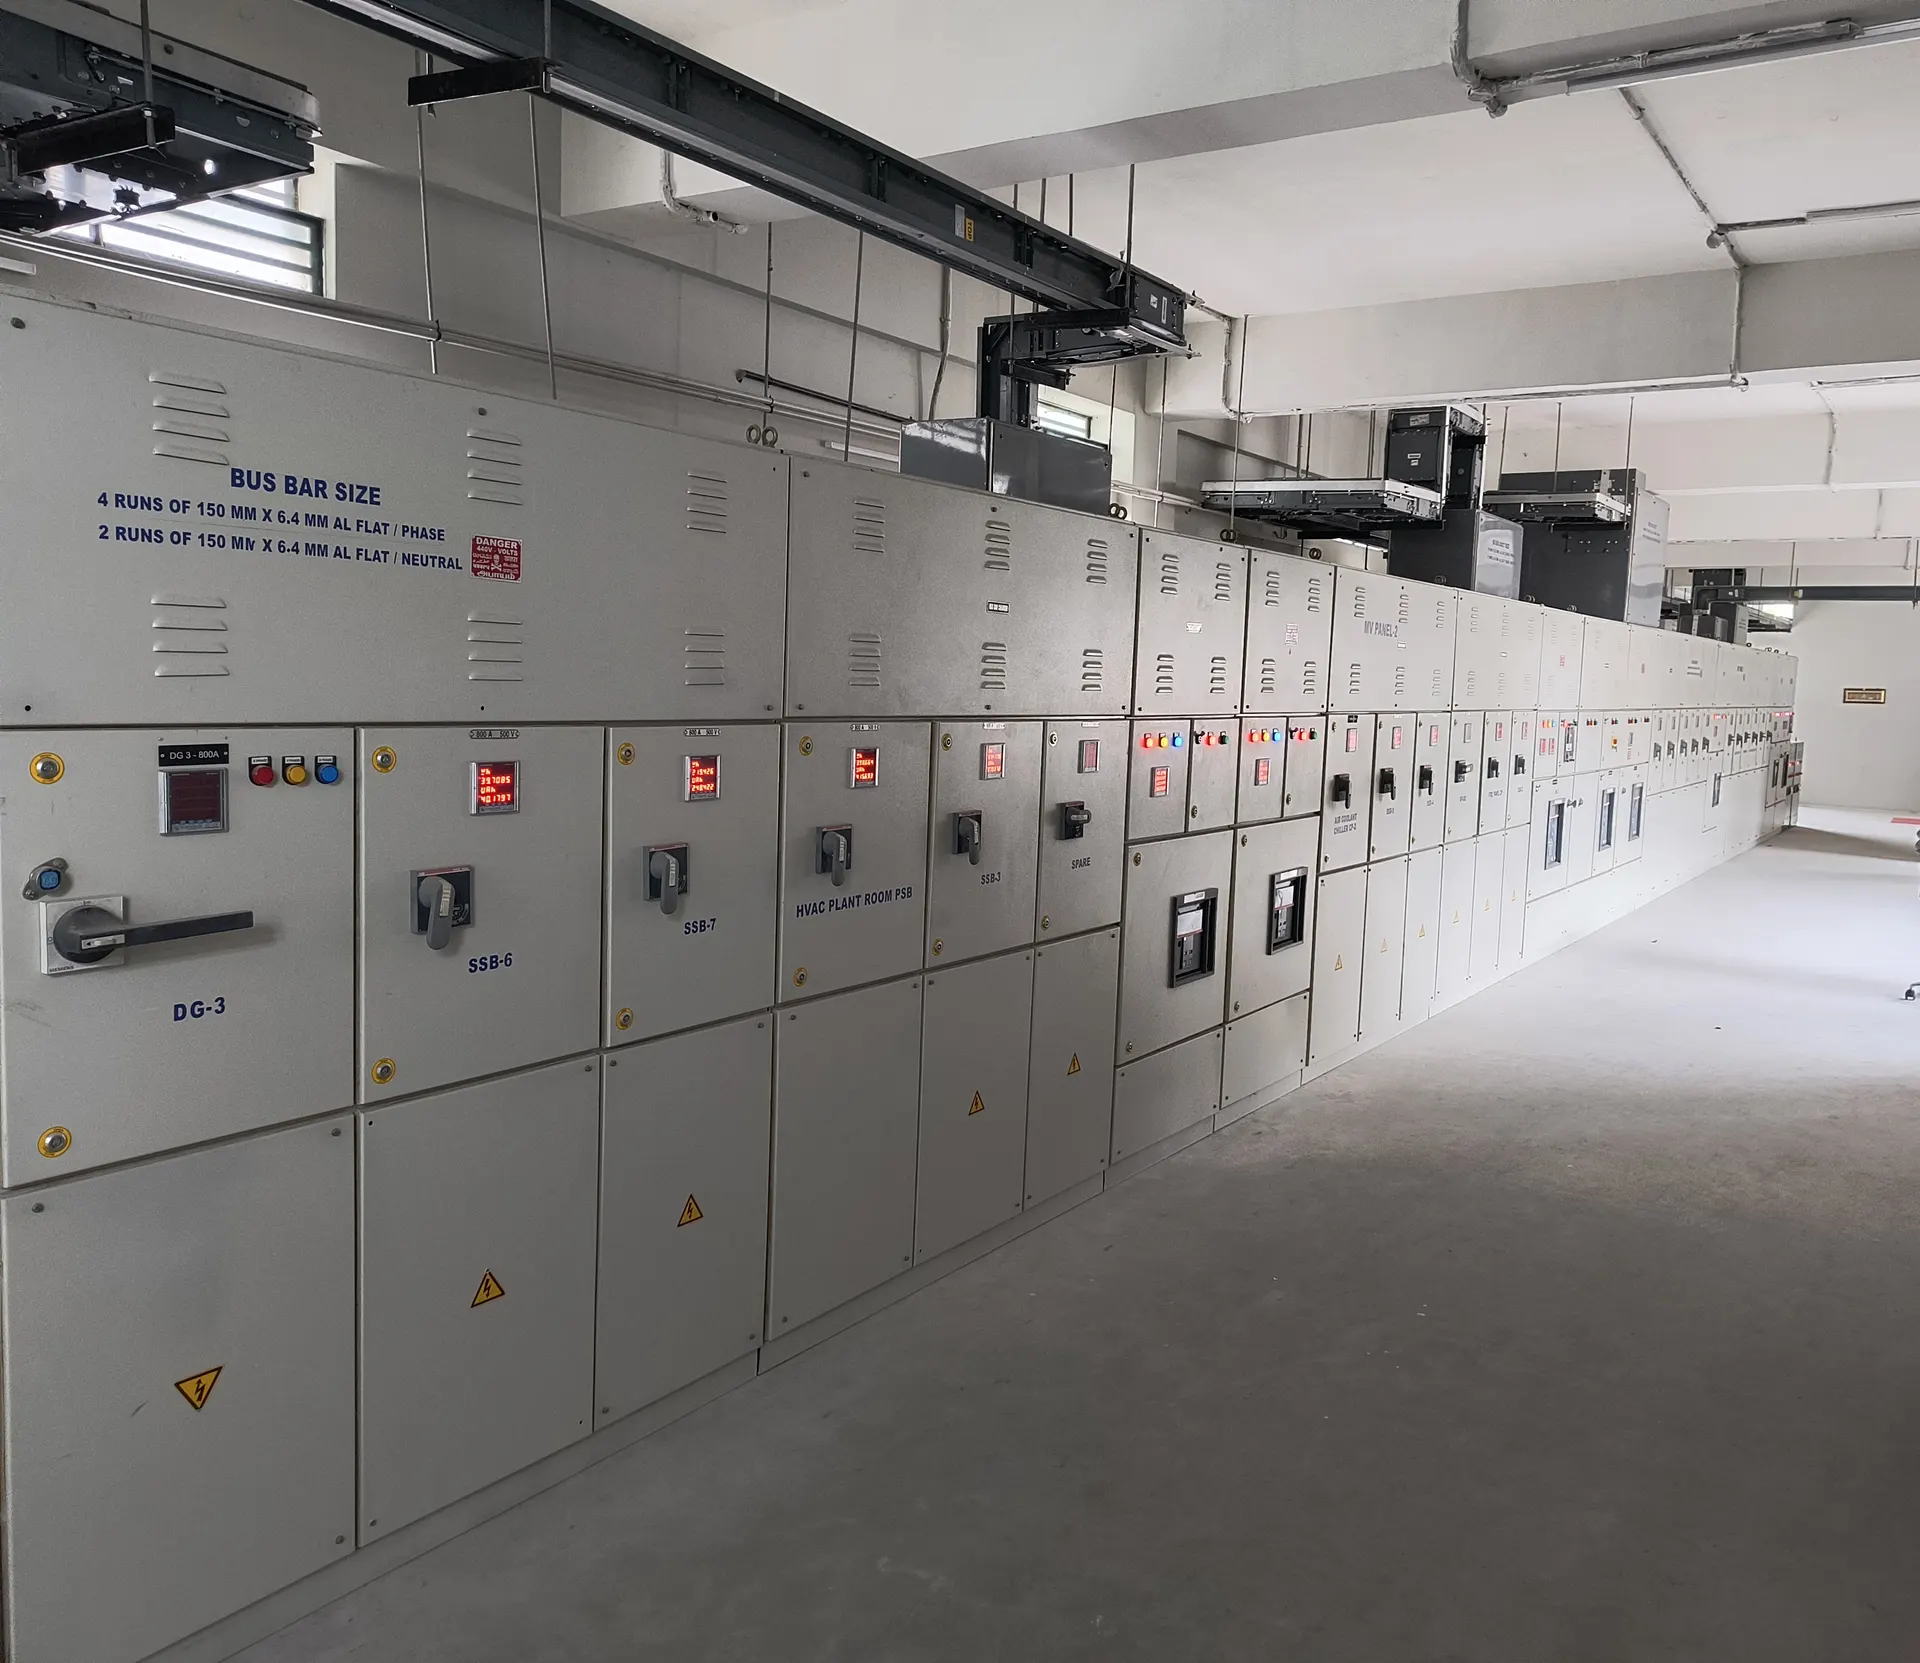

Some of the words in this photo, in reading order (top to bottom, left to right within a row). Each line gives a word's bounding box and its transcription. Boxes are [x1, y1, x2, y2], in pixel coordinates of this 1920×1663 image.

[230, 467, 276, 492] BUS
[285, 475, 328, 499] BAR
[335, 482, 380, 506] SIZE
[98, 492, 108, 507] 4
[115, 493, 163, 512] RUNS
[169, 499, 190, 514] OF
[197, 502, 225, 517] 150
[232, 505, 256, 521] MM
[262, 508, 272, 522] X
[278, 510, 299, 526] 6.4
[305, 513, 328, 529] MM
[333, 517, 351, 531] AL
[356, 519, 390, 536] FLAT
[394, 524, 398, 537] /
[402, 525, 445, 541] PHASE
[99, 524, 109, 540] 2
[116, 526, 163, 544] RUNS
[170, 531, 191, 546] OF
[198, 533, 225, 549] 150
[262, 538, 272, 552] X
[278, 540, 299, 555] 6.4
[305, 543, 328, 557] MM
[333, 545, 351, 560] AL
[356, 548, 390, 563] FLAT
[394, 552, 397, 564] /
[402, 552, 463, 570] NEUTRAL
[476, 537, 518, 549] DANGER
[498, 548, 518, 556] VOLTS
[1364, 620, 1374, 634] MV
[1375, 621, 1398, 638] PANEL-2
[170, 751, 184, 760] DG
[186, 751, 191, 760] 3
[198, 750, 220, 759] 800A
[1071, 857, 1091, 869] SPARE
[981, 872, 1001, 885] SSB-3
[796, 901, 825, 918] HVAC
[829, 895, 862, 912] PLANT
[864, 889, 893, 906] ROOM
[895, 886, 913, 901] PSB
[684, 917, 716, 935] SSB-7
[468, 952, 512, 973] SSB-6
[173, 996, 226, 1021] DG-3
